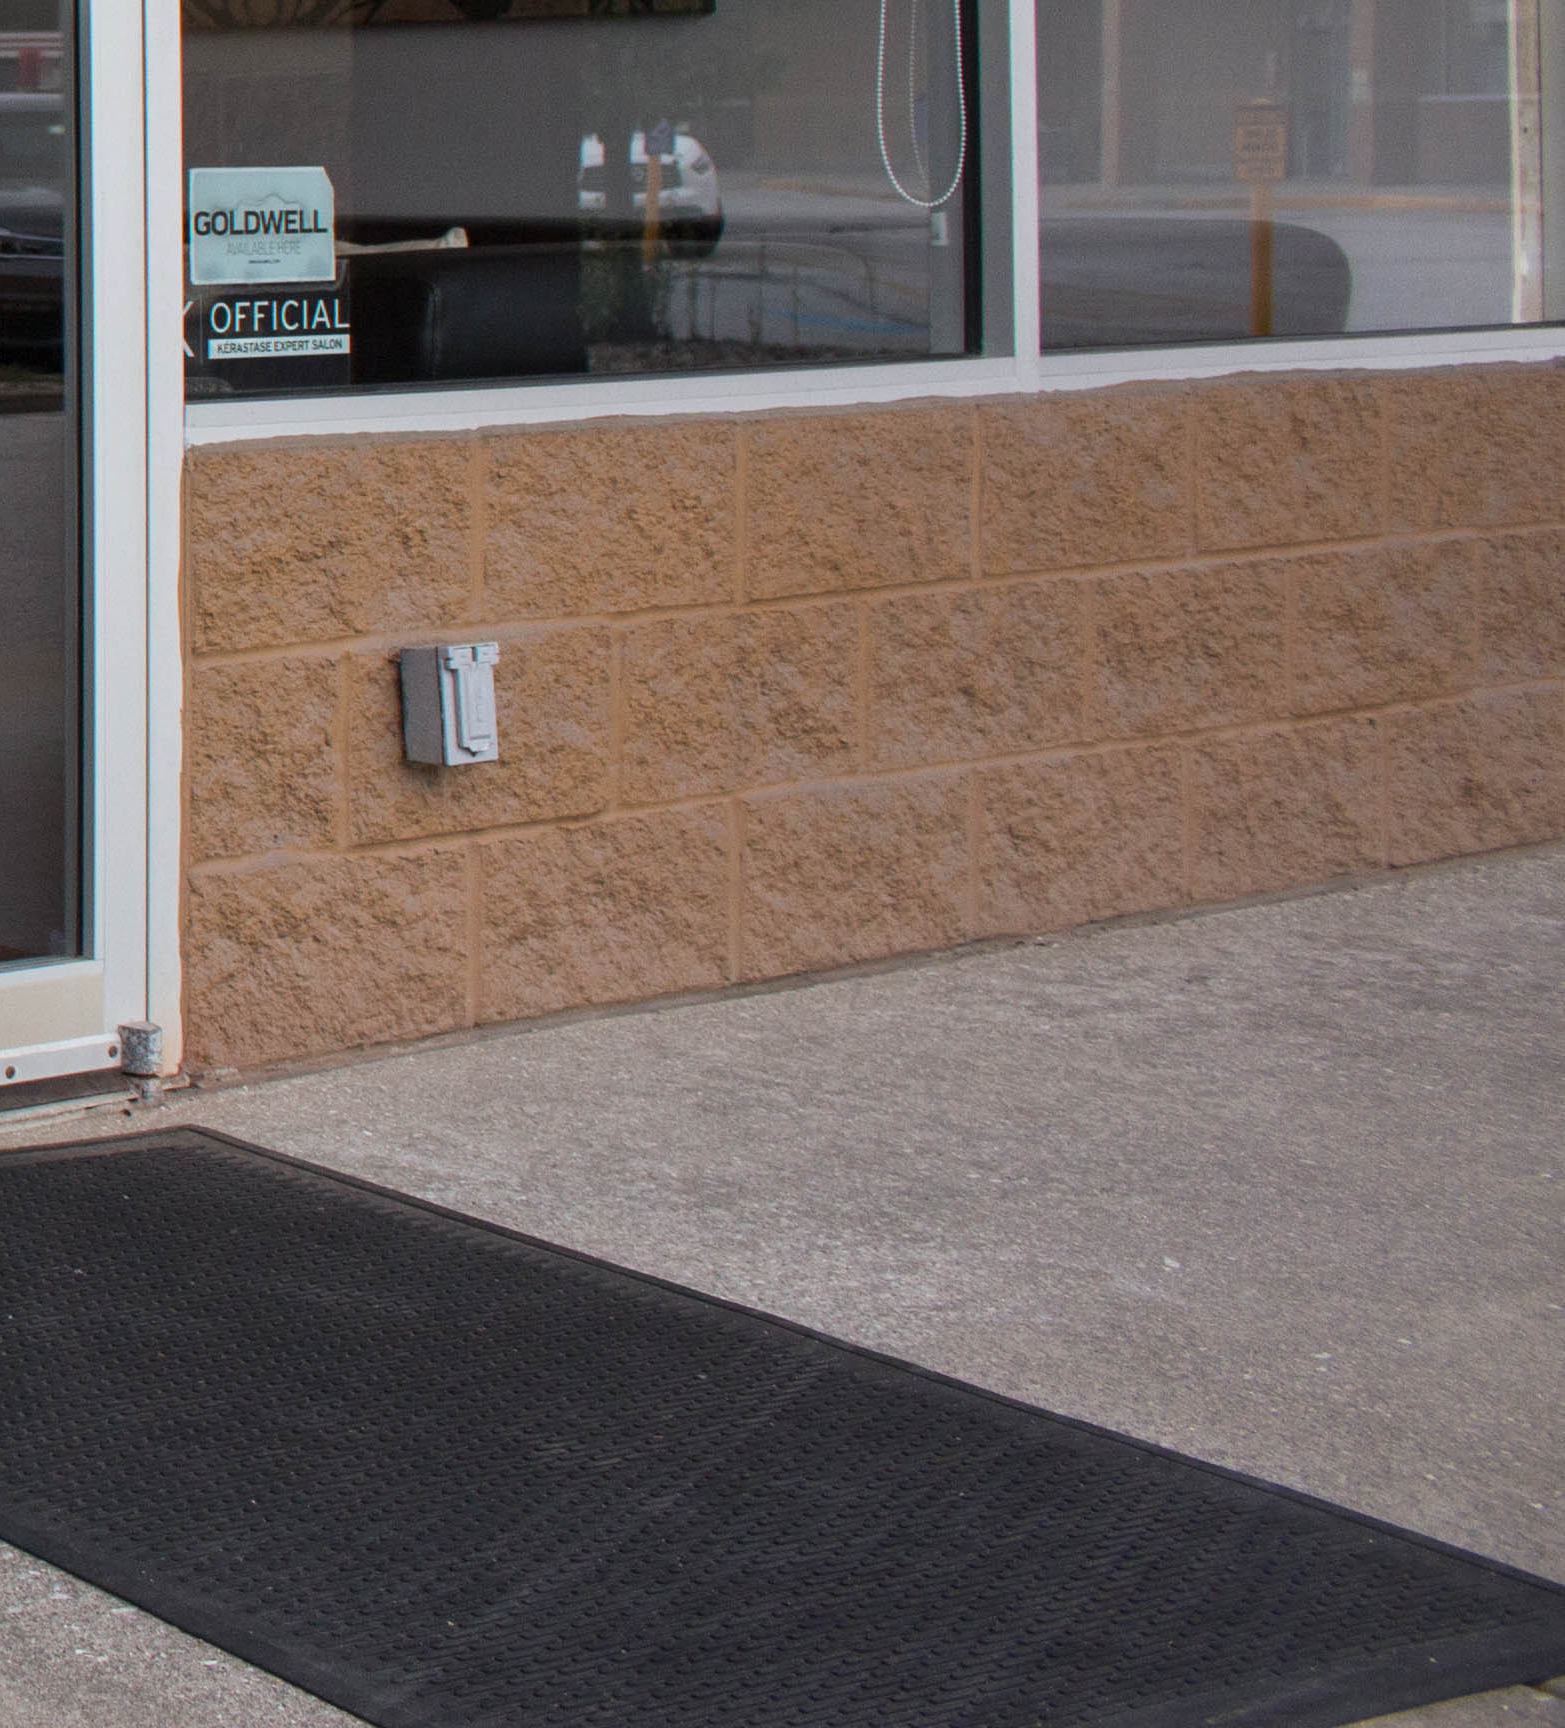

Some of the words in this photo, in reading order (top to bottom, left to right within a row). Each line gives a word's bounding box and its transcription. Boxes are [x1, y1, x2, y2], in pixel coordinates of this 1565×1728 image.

[194, 209, 328, 237] GOLDWELL
[209, 298, 351, 334] OFFICIAL
[273, 338, 311, 353] EXPERT
[311, 337, 343, 351] SALON
